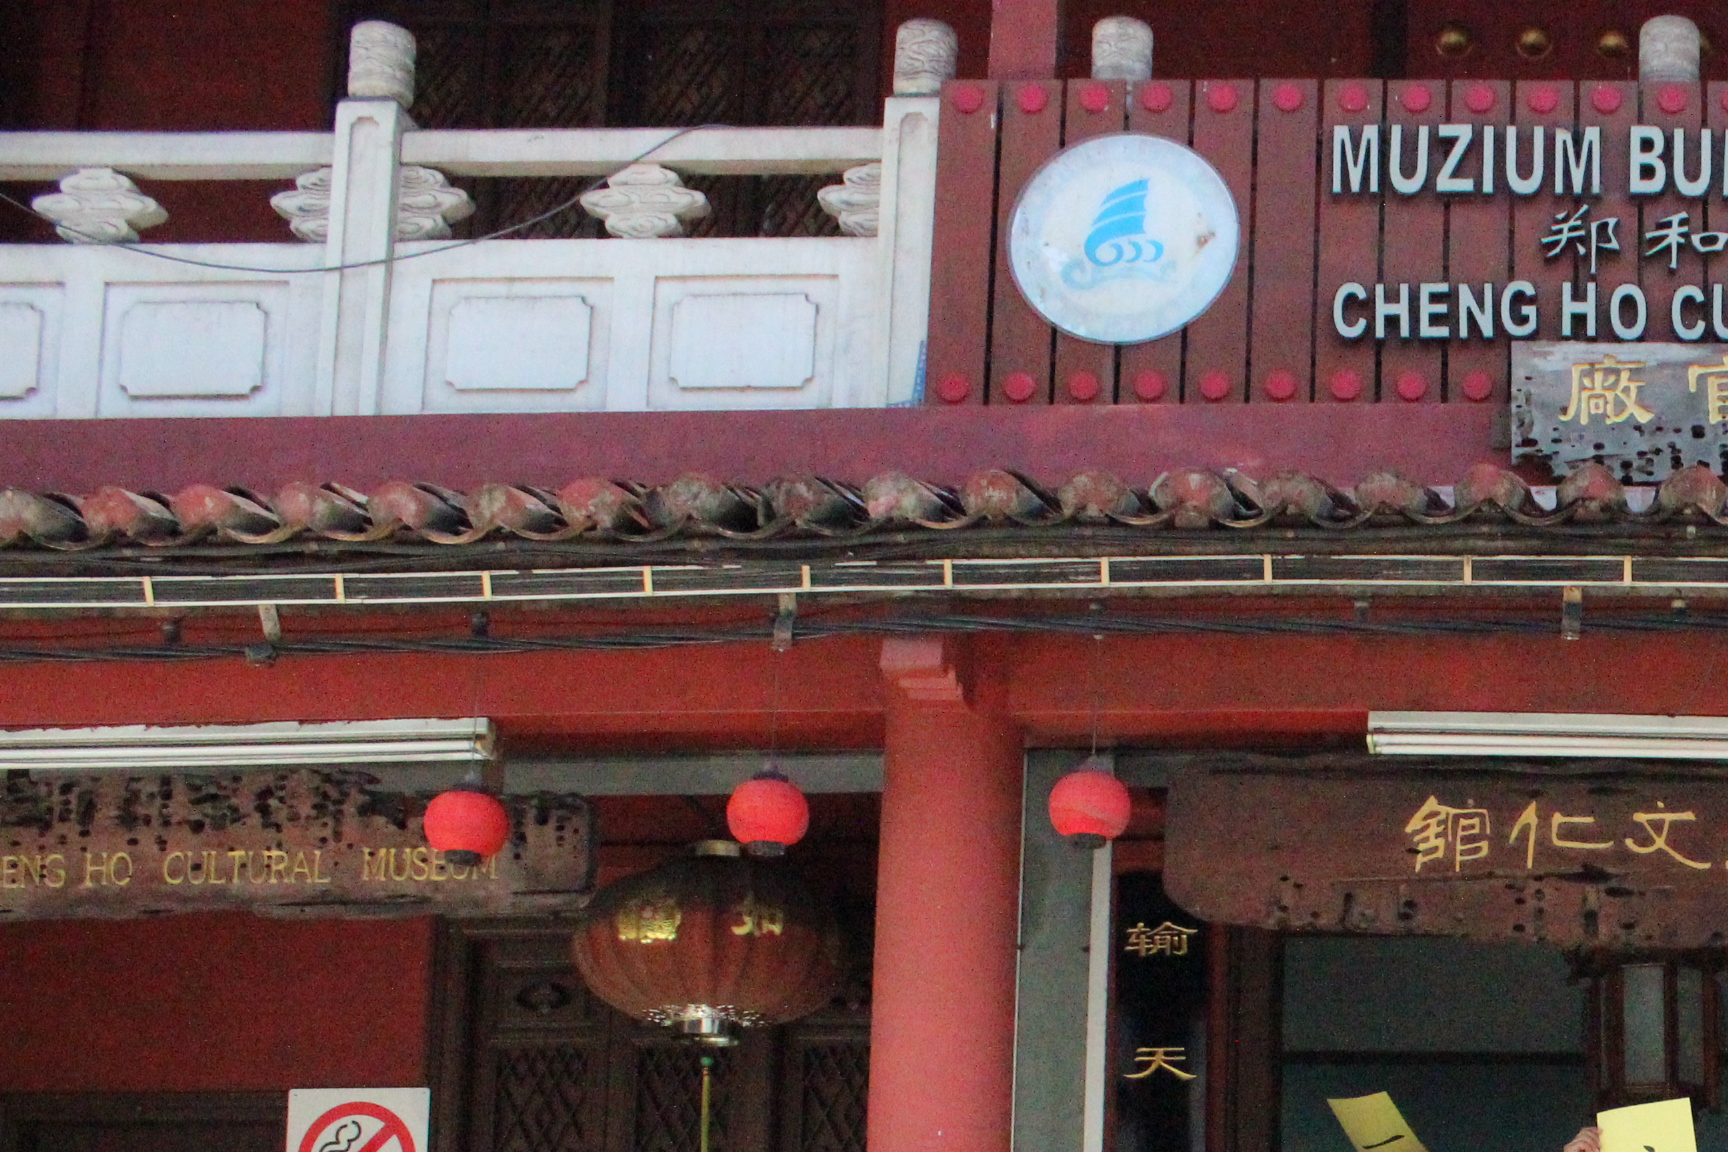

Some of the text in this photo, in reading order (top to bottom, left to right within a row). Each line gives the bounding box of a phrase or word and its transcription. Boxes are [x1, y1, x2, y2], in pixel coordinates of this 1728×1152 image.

[1332, 123, 1600, 195] MUZIUM
[1332, 280, 1539, 340] CHENG
[1560, 283, 1648, 341] HO
[0, 853, 66, 889] ENG
[84, 851, 134, 887] HO
[163, 848, 332, 886] CULTURAL
[1362, 1133, 1405, 1151] 一
